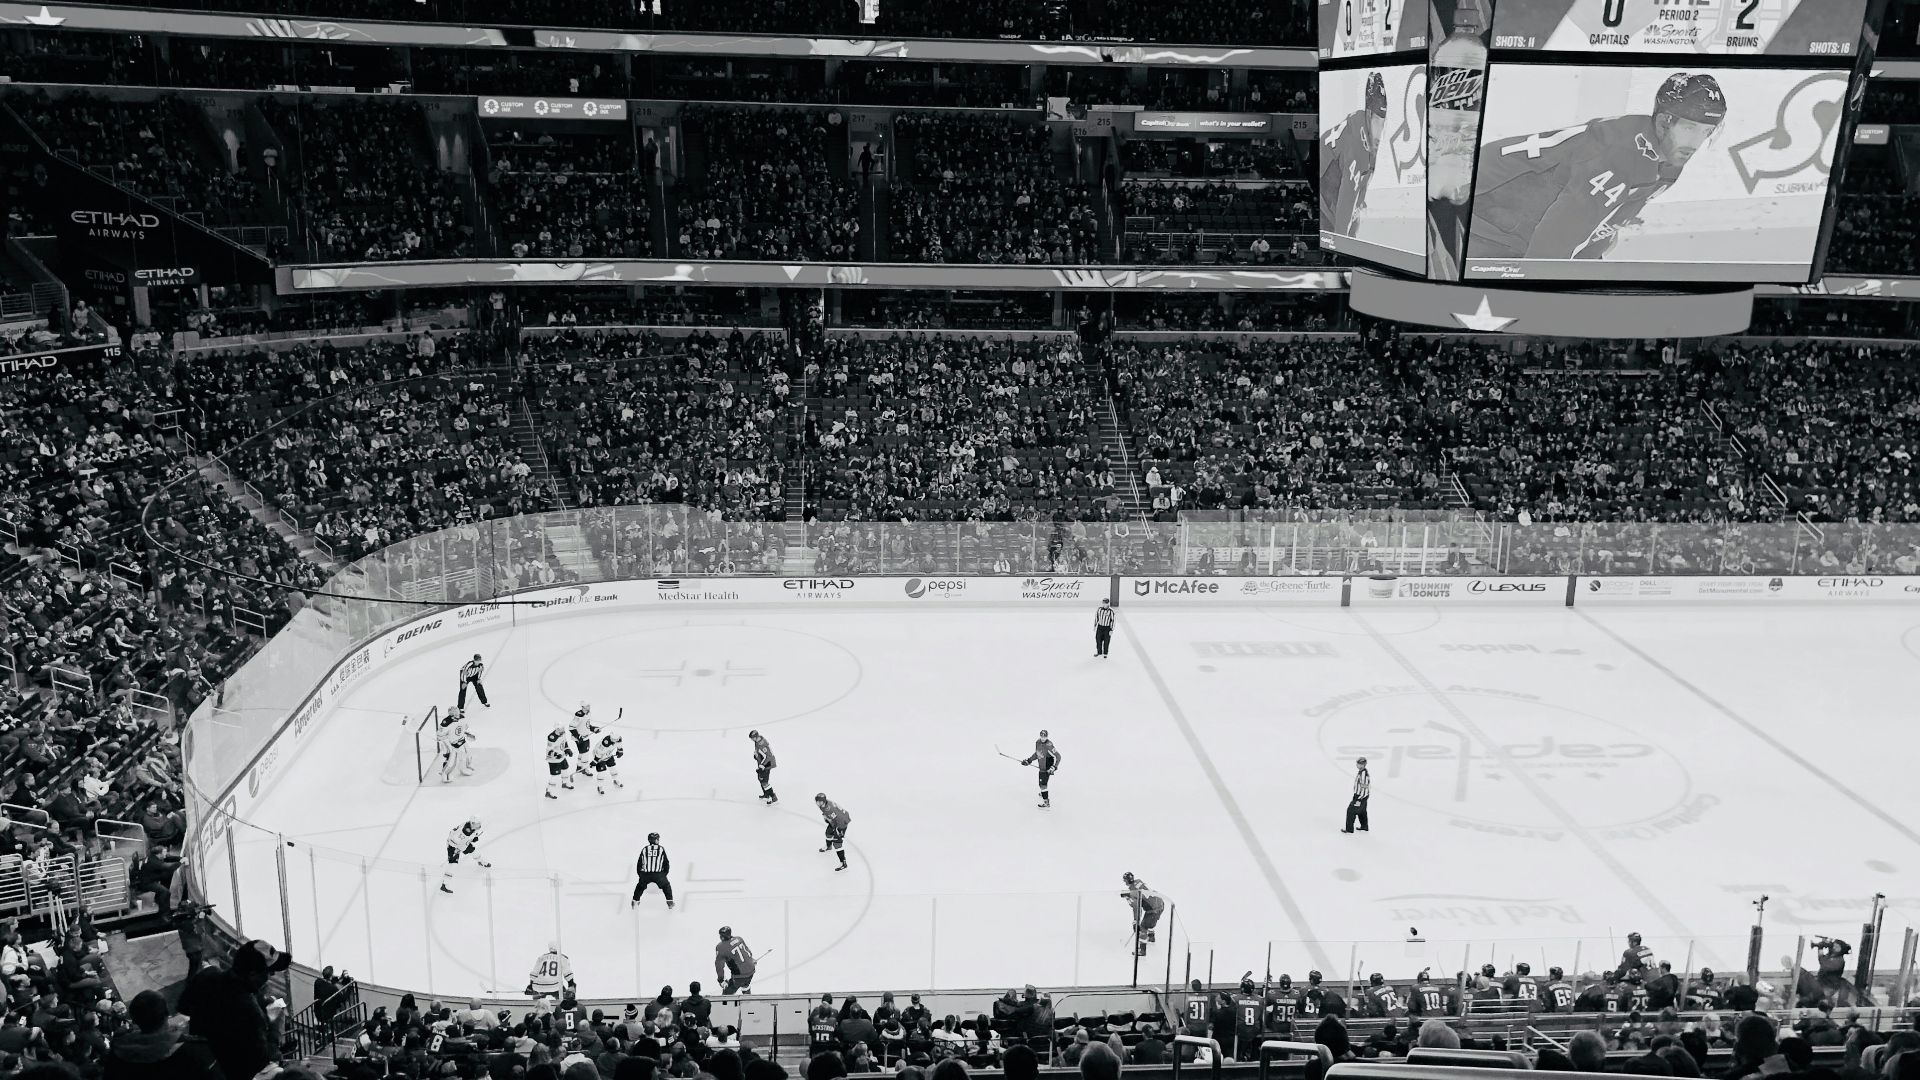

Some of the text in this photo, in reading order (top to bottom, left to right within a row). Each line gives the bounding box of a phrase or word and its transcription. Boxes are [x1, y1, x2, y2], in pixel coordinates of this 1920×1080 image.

[1659, 9, 1699, 21] PERIOD 2
[1736, 0, 1760, 30] 2
[1495, 36, 1526, 48] SHOTS:
[1589, 33, 1630, 46] CAPITALS
[1726, 36, 1759, 48] BRUINS
[1809, 42, 1850, 54] SHOTS: 16
[1097, 118, 1111, 127] 215
[1293, 120, 1308, 130] 215
[1073, 127, 1087, 137] 216
[1588, 170, 1626, 208] 44
[70, 210, 160, 228] ETIHAD
[89, 228, 145, 240] AIRWAYS
[84, 269, 125, 283] ETIHAD
[134, 267, 195, 279] ETIHAD
[104, 347, 121, 358] 115
[0, 355, 58, 373] TIHAD
[783, 579, 855, 589] ETIHAD
[928, 578, 967, 593] pepsi
[1039, 578, 1085, 591] Sports
[1154, 579, 1219, 594] McAfee
[1270, 580, 1304, 592] Greene
[1304, 580, 1332, 590] Turtle
[1488, 583, 1546, 592] LEXUS
[1817, 578, 1884, 588] ETIHAD
[594, 593, 618, 602] Bank
[658, 591, 739, 601] MedStar Health
[1022, 591, 1080, 599] WASHINGTON
[1412, 590, 1451, 598] DONUTS
[396, 619, 443, 644] BOEING
[1389, 904, 1588, 926] Red River
[539, 960, 558, 977] 48
[1519, 982, 1538, 1000] 43
[1423, 992, 1441, 1011] 10
[1189, 1001, 1205, 1020] 31
[1244, 1007, 1255, 1026] 8
[1277, 1005, 1296, 1022] 39
[565, 1012, 575, 1030] 8
[430, 1034, 444, 1053] 8
